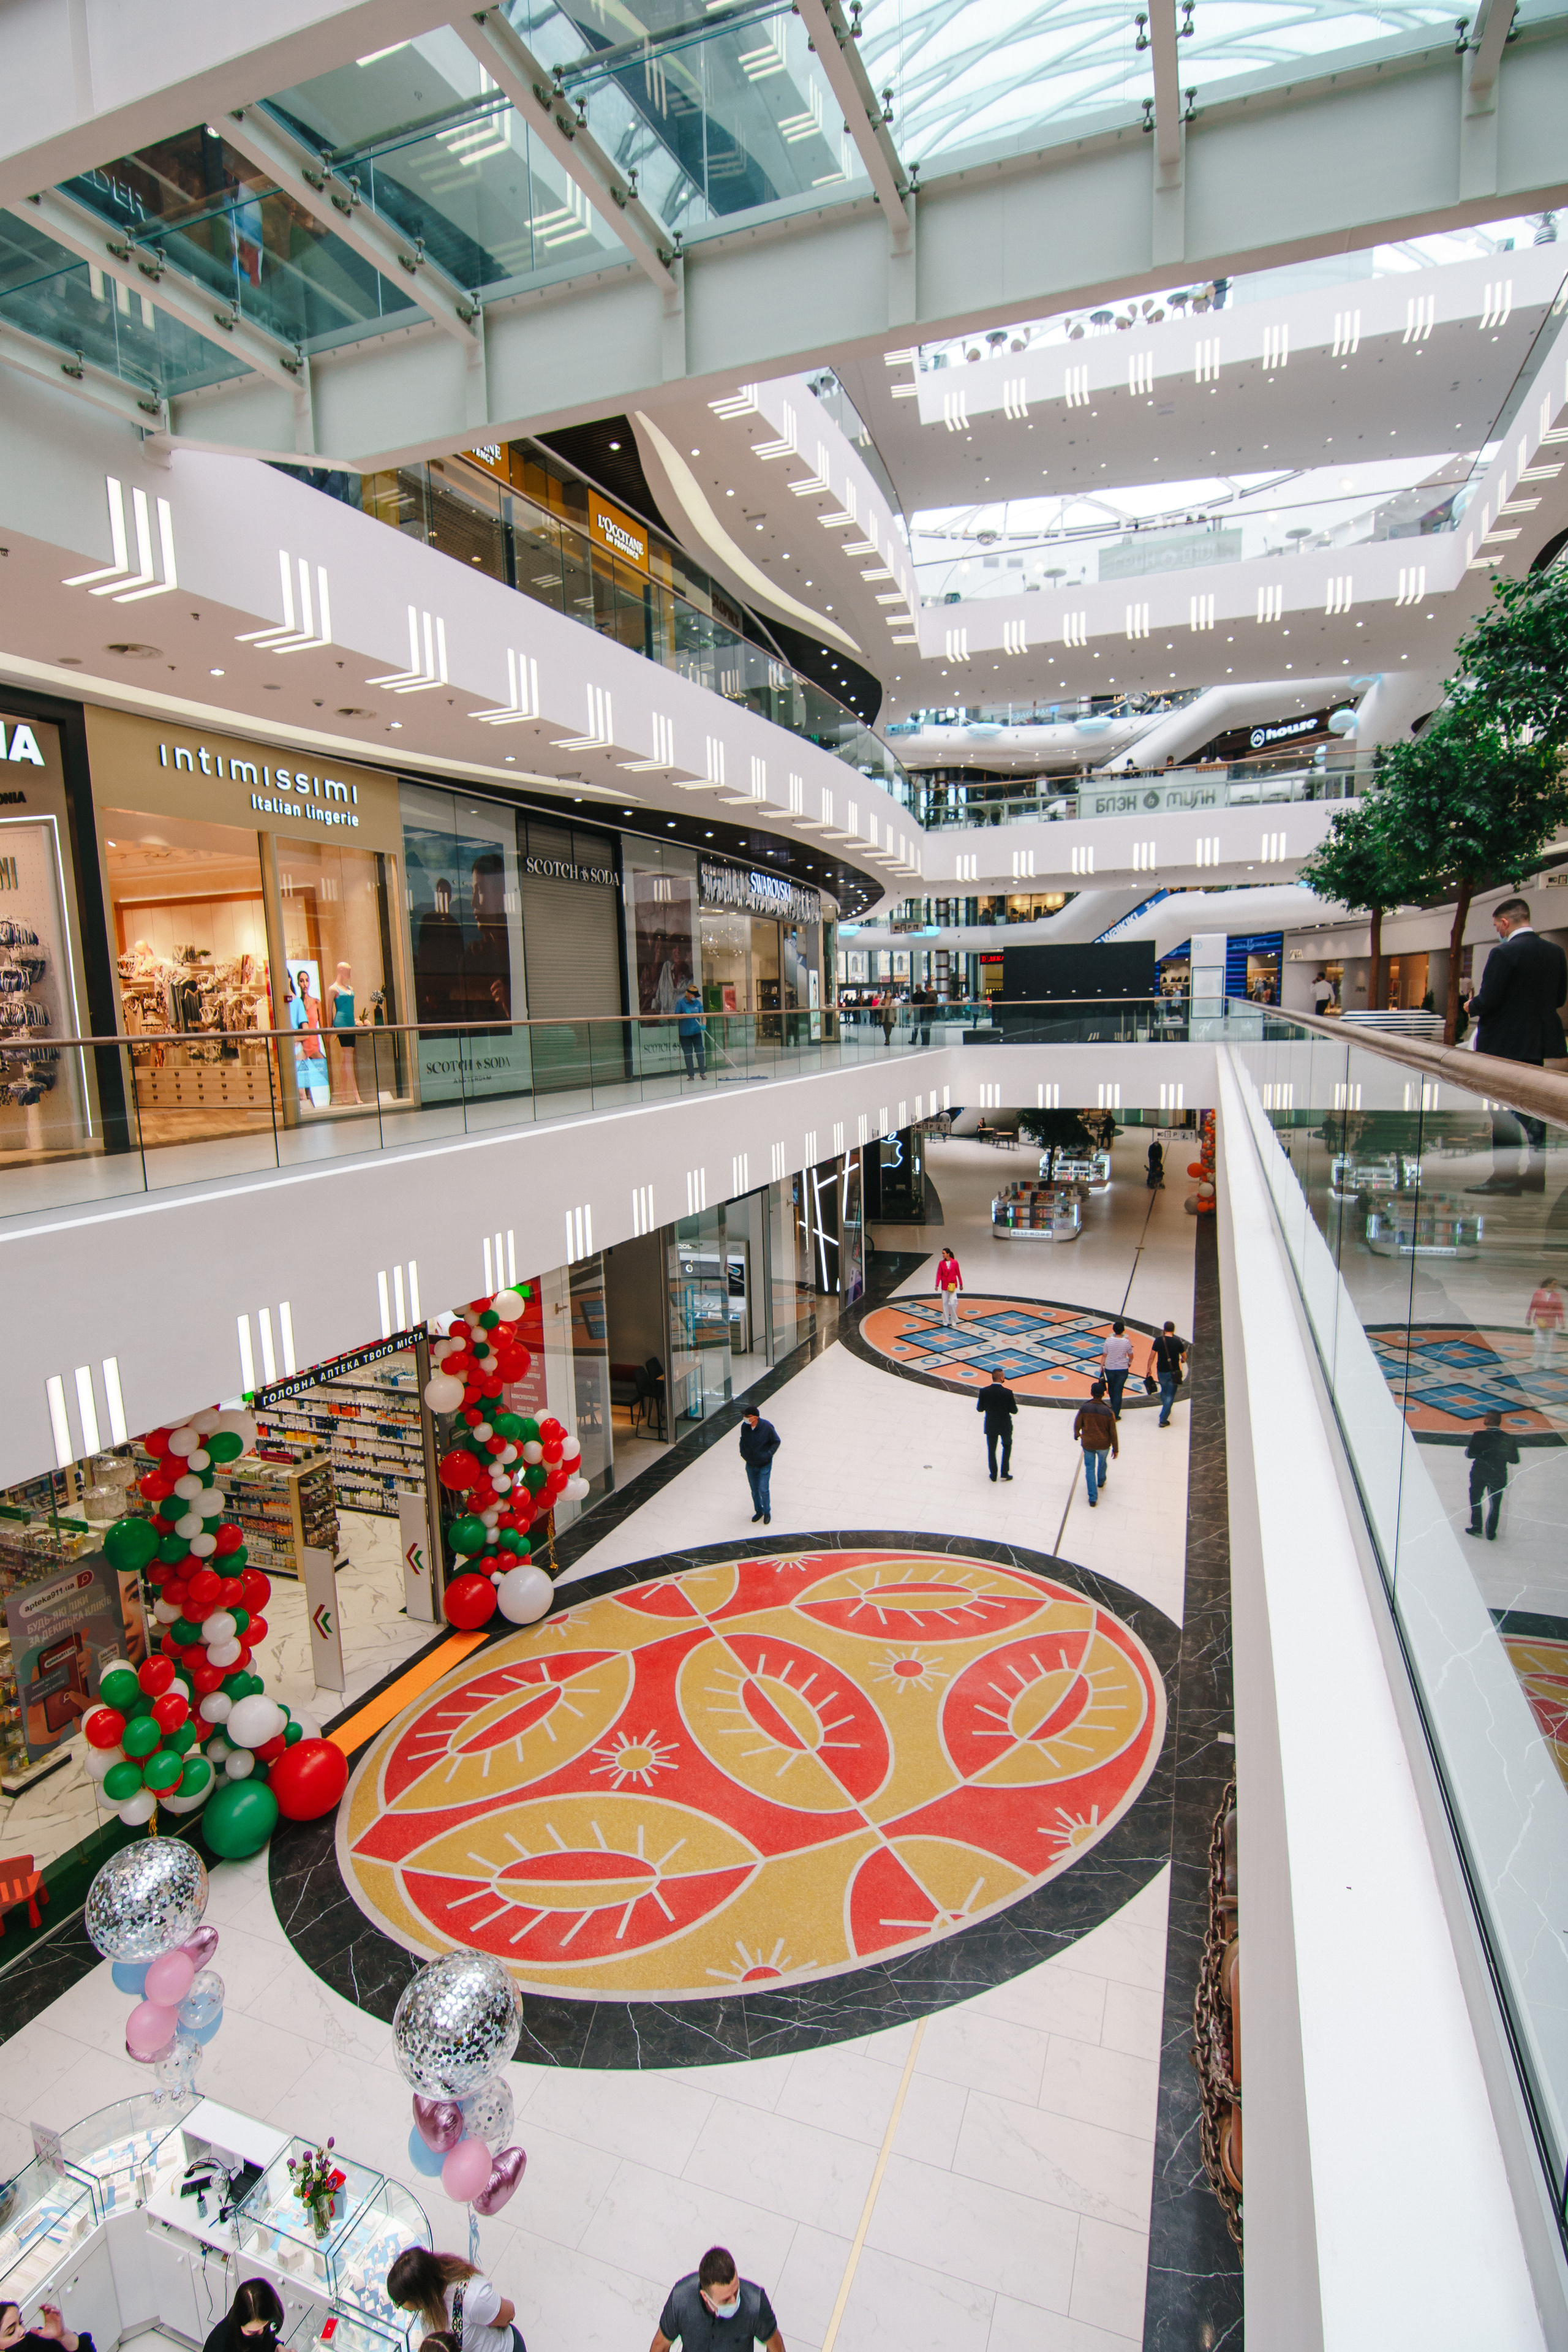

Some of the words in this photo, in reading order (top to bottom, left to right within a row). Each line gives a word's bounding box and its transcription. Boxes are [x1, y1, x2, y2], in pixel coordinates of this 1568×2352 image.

[598, 514, 644, 556] L'OCCITANE
[614, 538, 639, 560] PROVENCE
[1265, 718, 1318, 741] house
[251, 793, 301, 817] Italian
[305, 803, 359, 827] lingerie
[526, 857, 579, 880] SCOTCH
[590, 868, 620, 886] SODA
[750, 872, 791, 903] SWAROVSKI
[484, 1057, 510, 1069] SODA
[262, 1376, 316, 1406] ГОЛОВНА
[320, 1359, 360, 1382] АПТЕКА
[363, 1344, 393, 1363] ТВОГО
[397, 1331, 424, 1350] МІСТА
[25, 1583, 74, 1611] apteka911.ua
[27, 1605, 67, 1634] БУДЬ-ЯКІ
[69, 1594, 89, 1612] ЛІКИ
[29, 1634, 40, 1648] ЗА
[42, 1610, 84, 1643] ДЕКІЛЬКА
